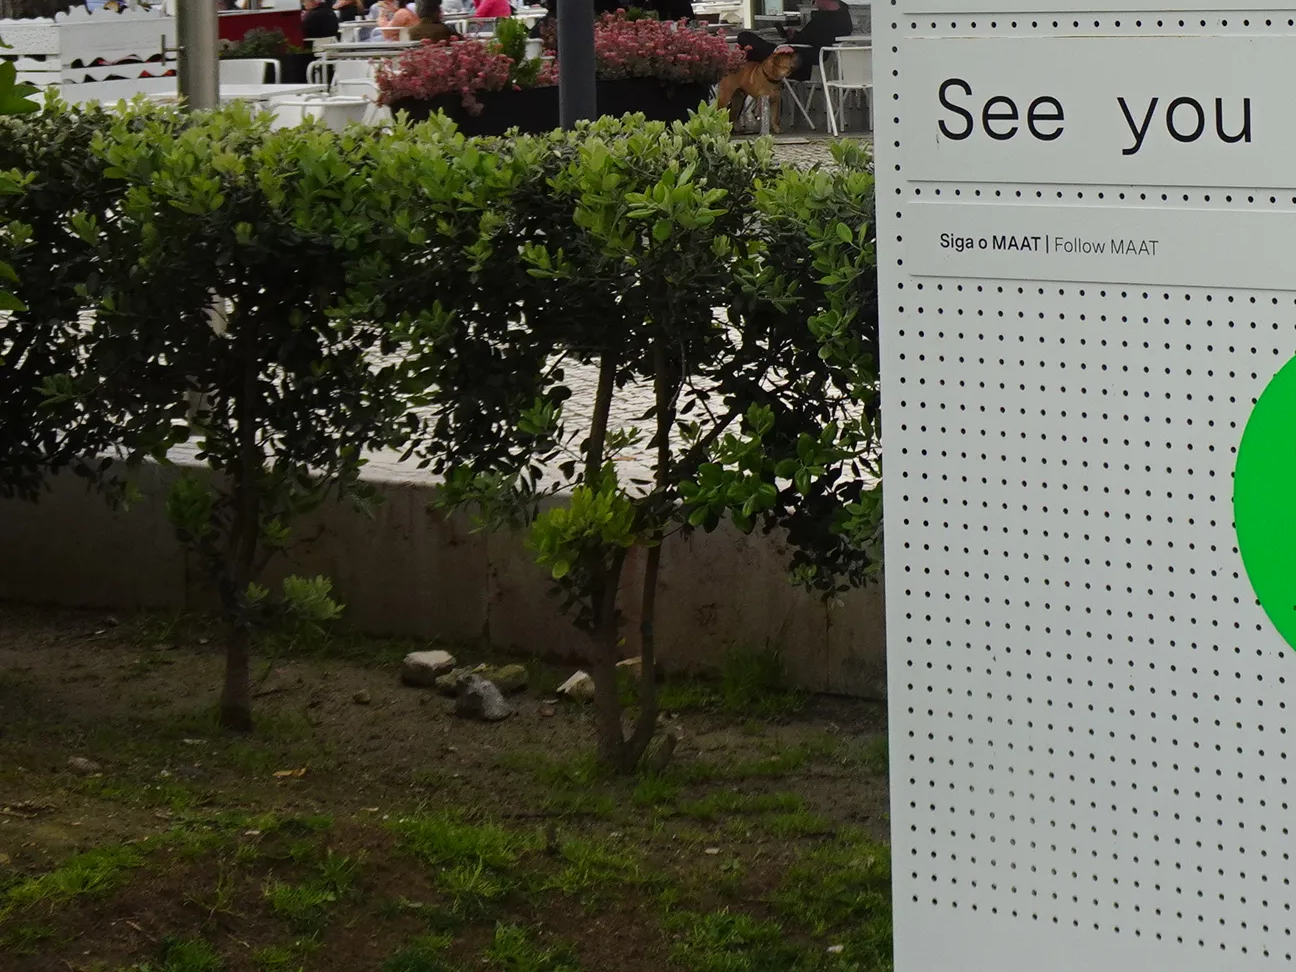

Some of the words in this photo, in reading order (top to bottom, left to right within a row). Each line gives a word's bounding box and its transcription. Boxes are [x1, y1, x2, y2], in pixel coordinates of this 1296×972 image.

[937, 78, 1066, 141] See
[1117, 97, 1252, 155] you
[940, 233, 974, 252] Siga
[978, 238, 988, 250] o
[992, 235, 1041, 251] MAAT
[1055, 237, 1106, 254] Follow
[1110, 239, 1159, 256] MAAT
